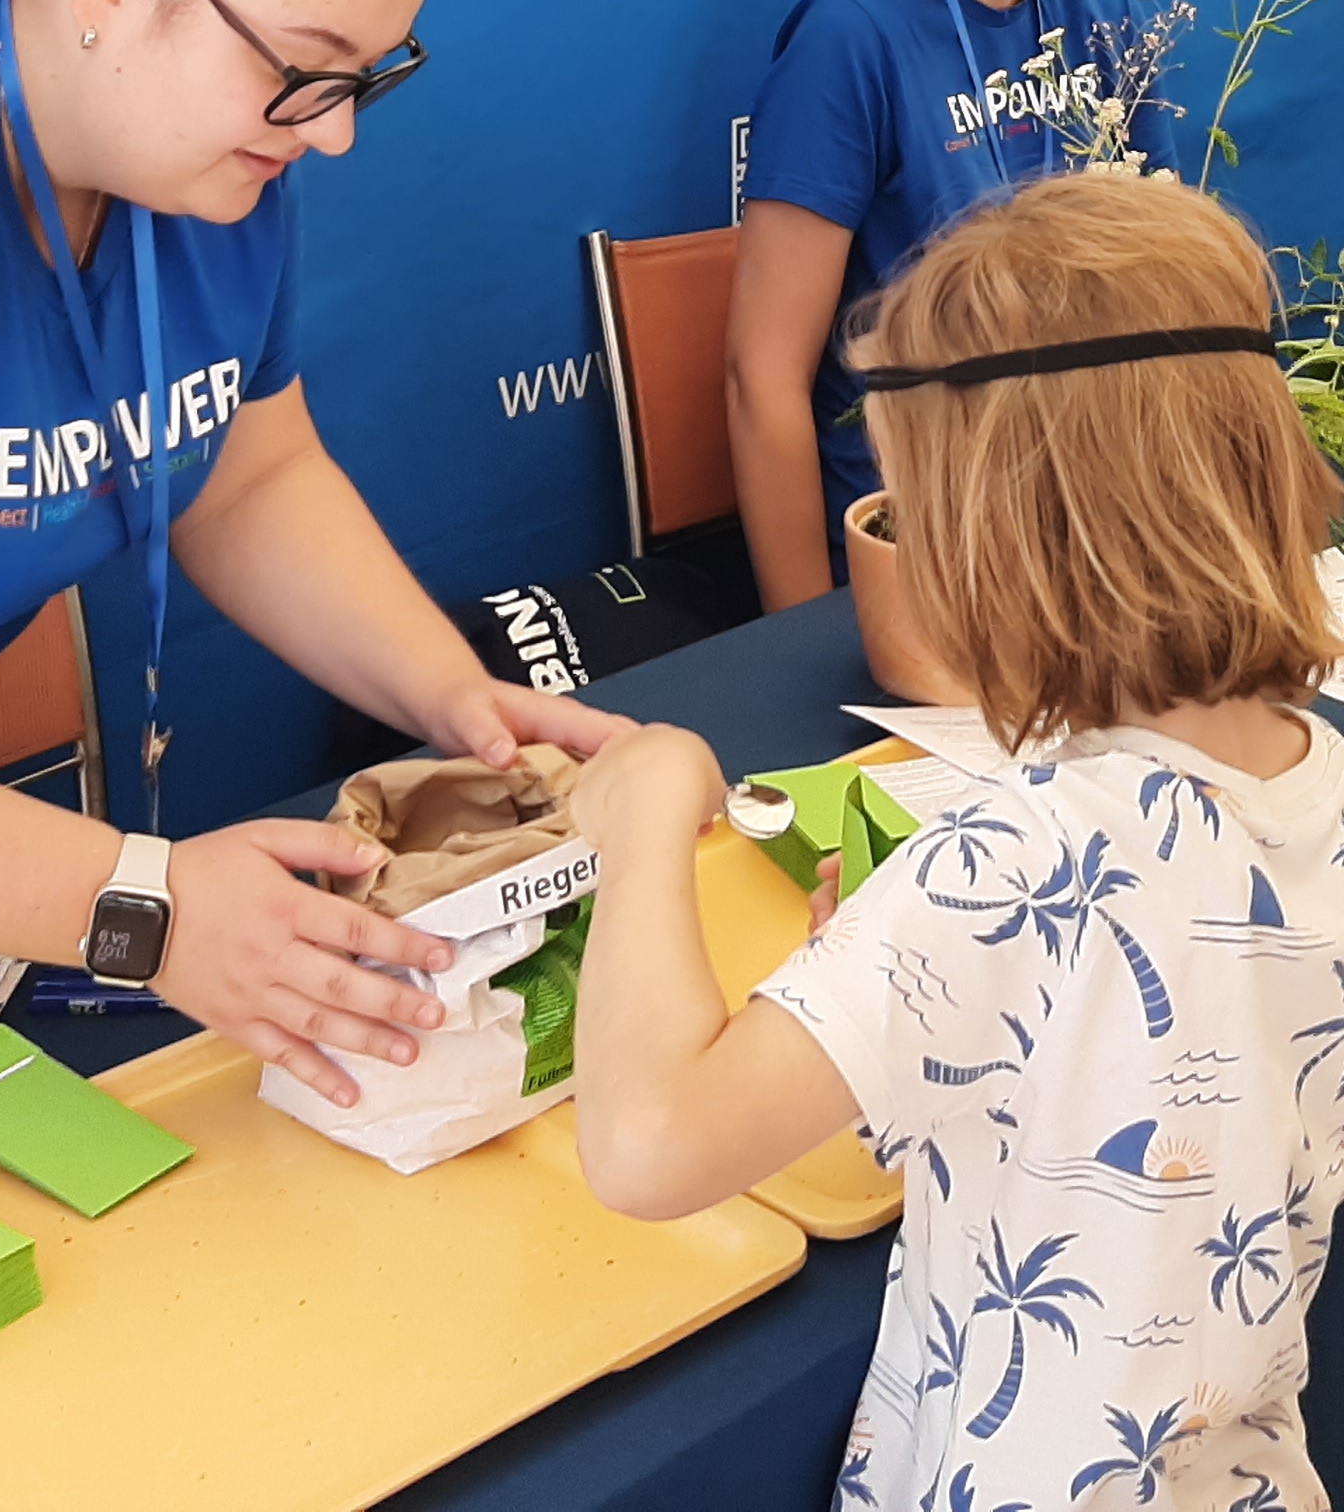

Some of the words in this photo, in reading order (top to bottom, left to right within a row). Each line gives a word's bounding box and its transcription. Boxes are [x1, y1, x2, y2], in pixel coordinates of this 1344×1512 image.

[947, 74, 1102, 135] EMPOWR
[497, 349, 605, 419] ww
[499, 849, 599, 916] Rieger
